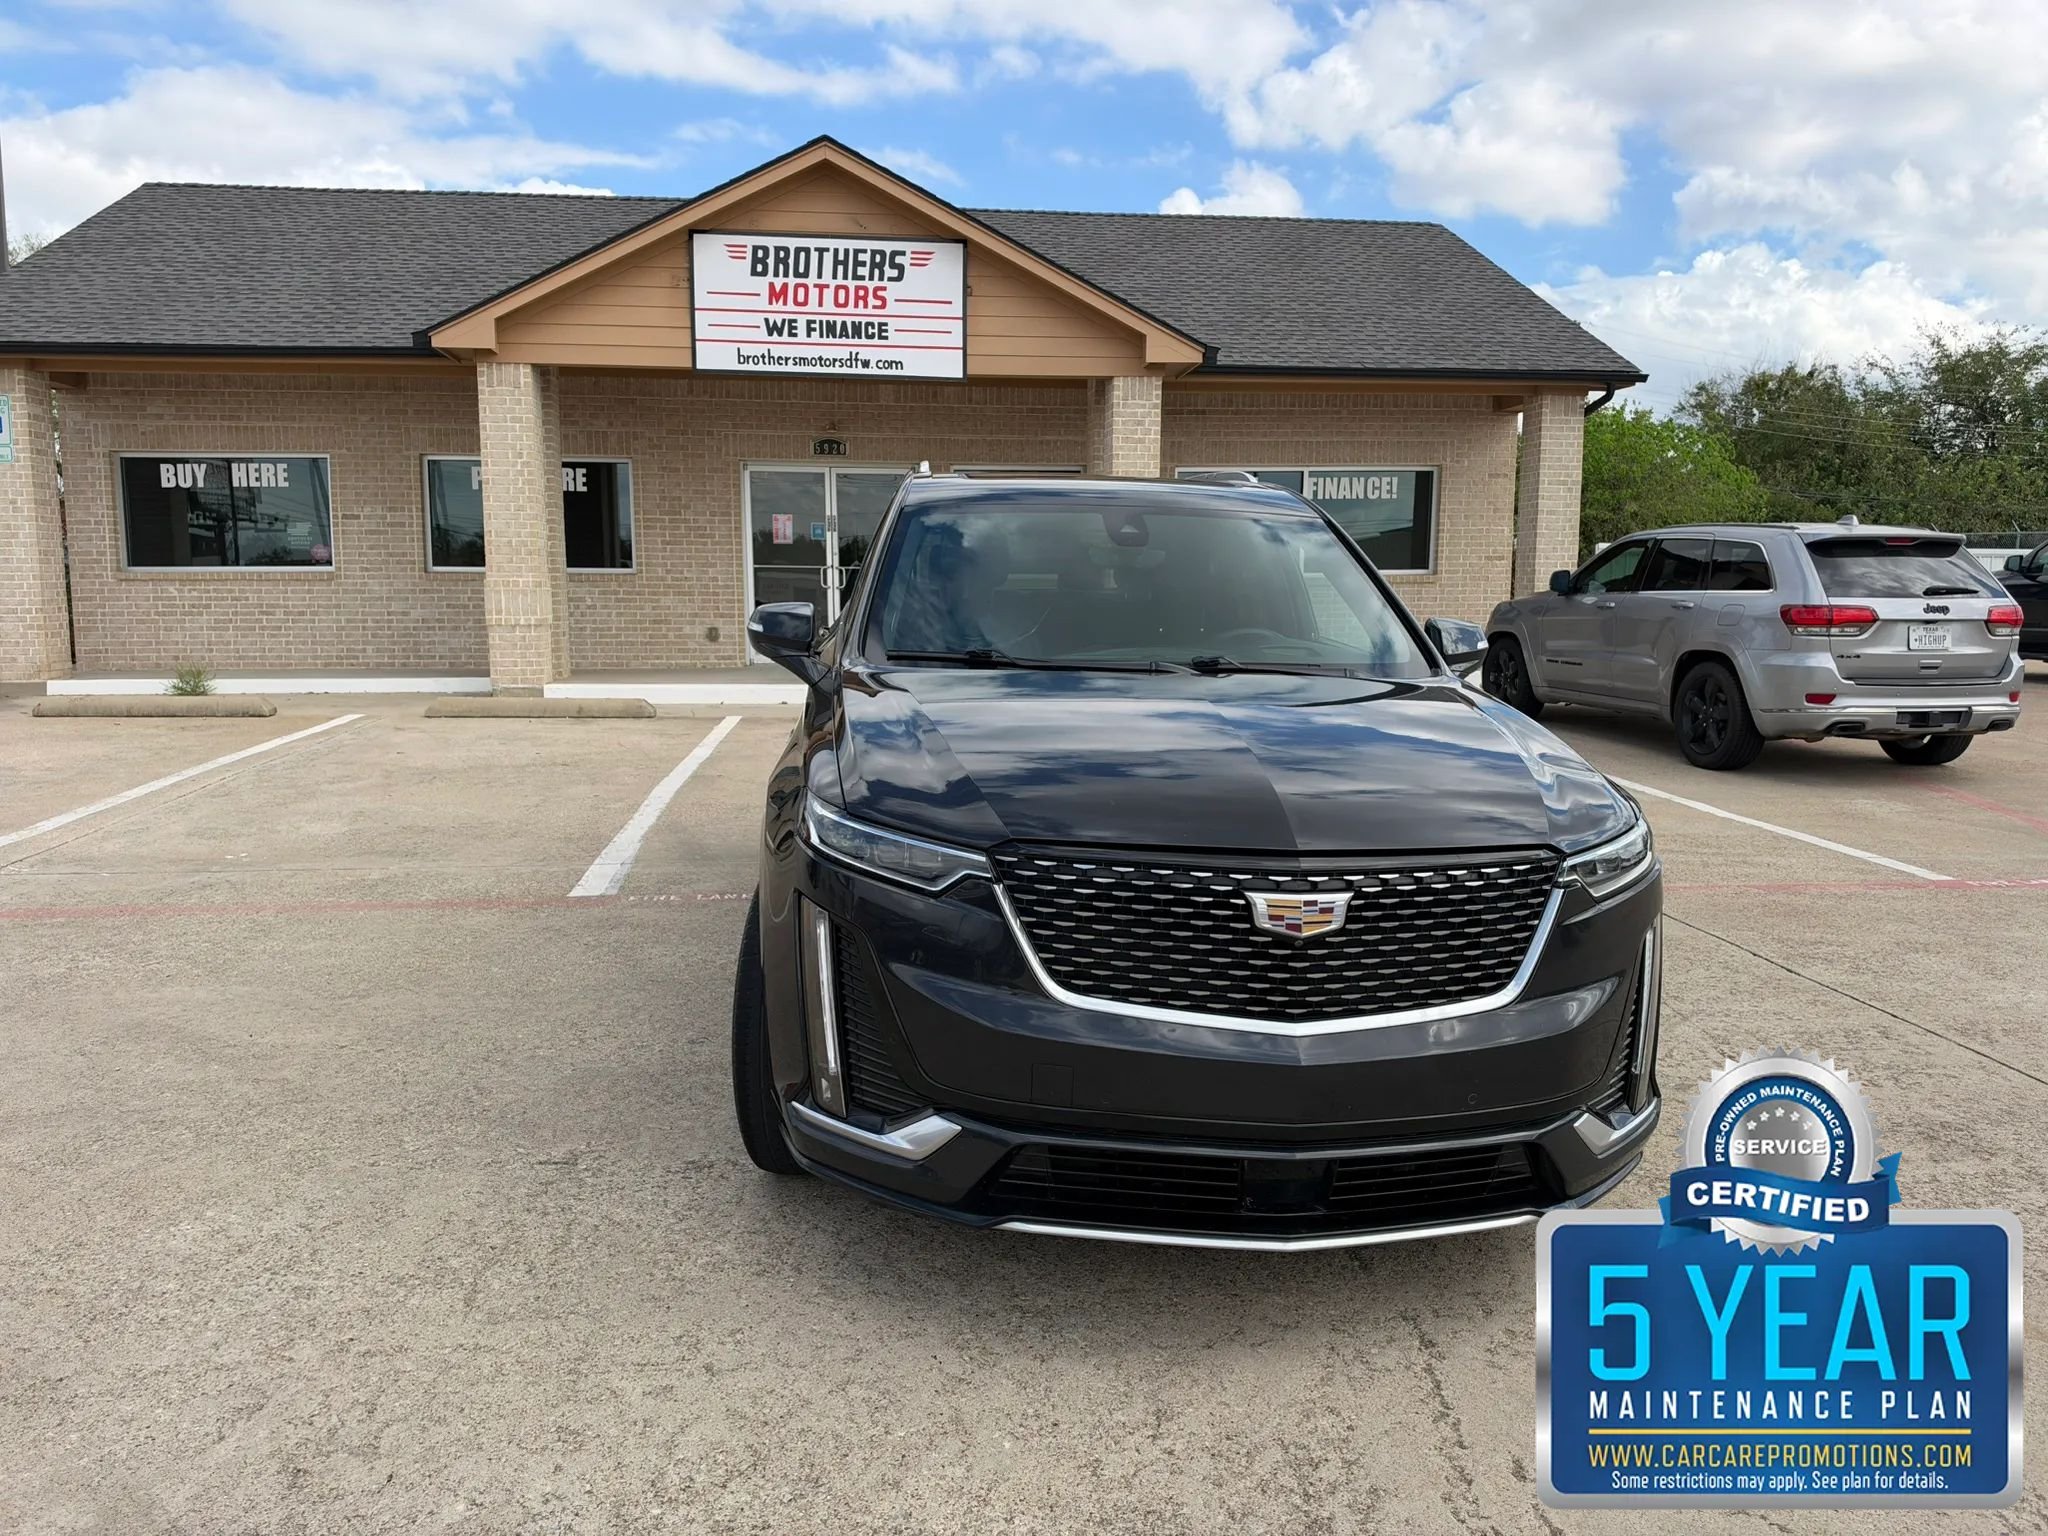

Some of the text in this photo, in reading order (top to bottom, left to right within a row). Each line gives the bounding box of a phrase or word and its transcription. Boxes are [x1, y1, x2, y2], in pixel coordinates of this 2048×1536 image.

[750, 244, 907, 283] BROTHERS
[767, 281, 888, 311] MOTORS
[763, 317, 889, 341] WE FINANCE
[736, 347, 904, 371] brothersmotorsdfw.com
[815, 443, 845, 455] 5920
[159, 463, 289, 489] BUY HERE
[1308, 476, 1398, 500] FINANCE!
[1923, 603, 1950, 616] Jeep
[1918, 634, 1947, 646] HIGHUP
